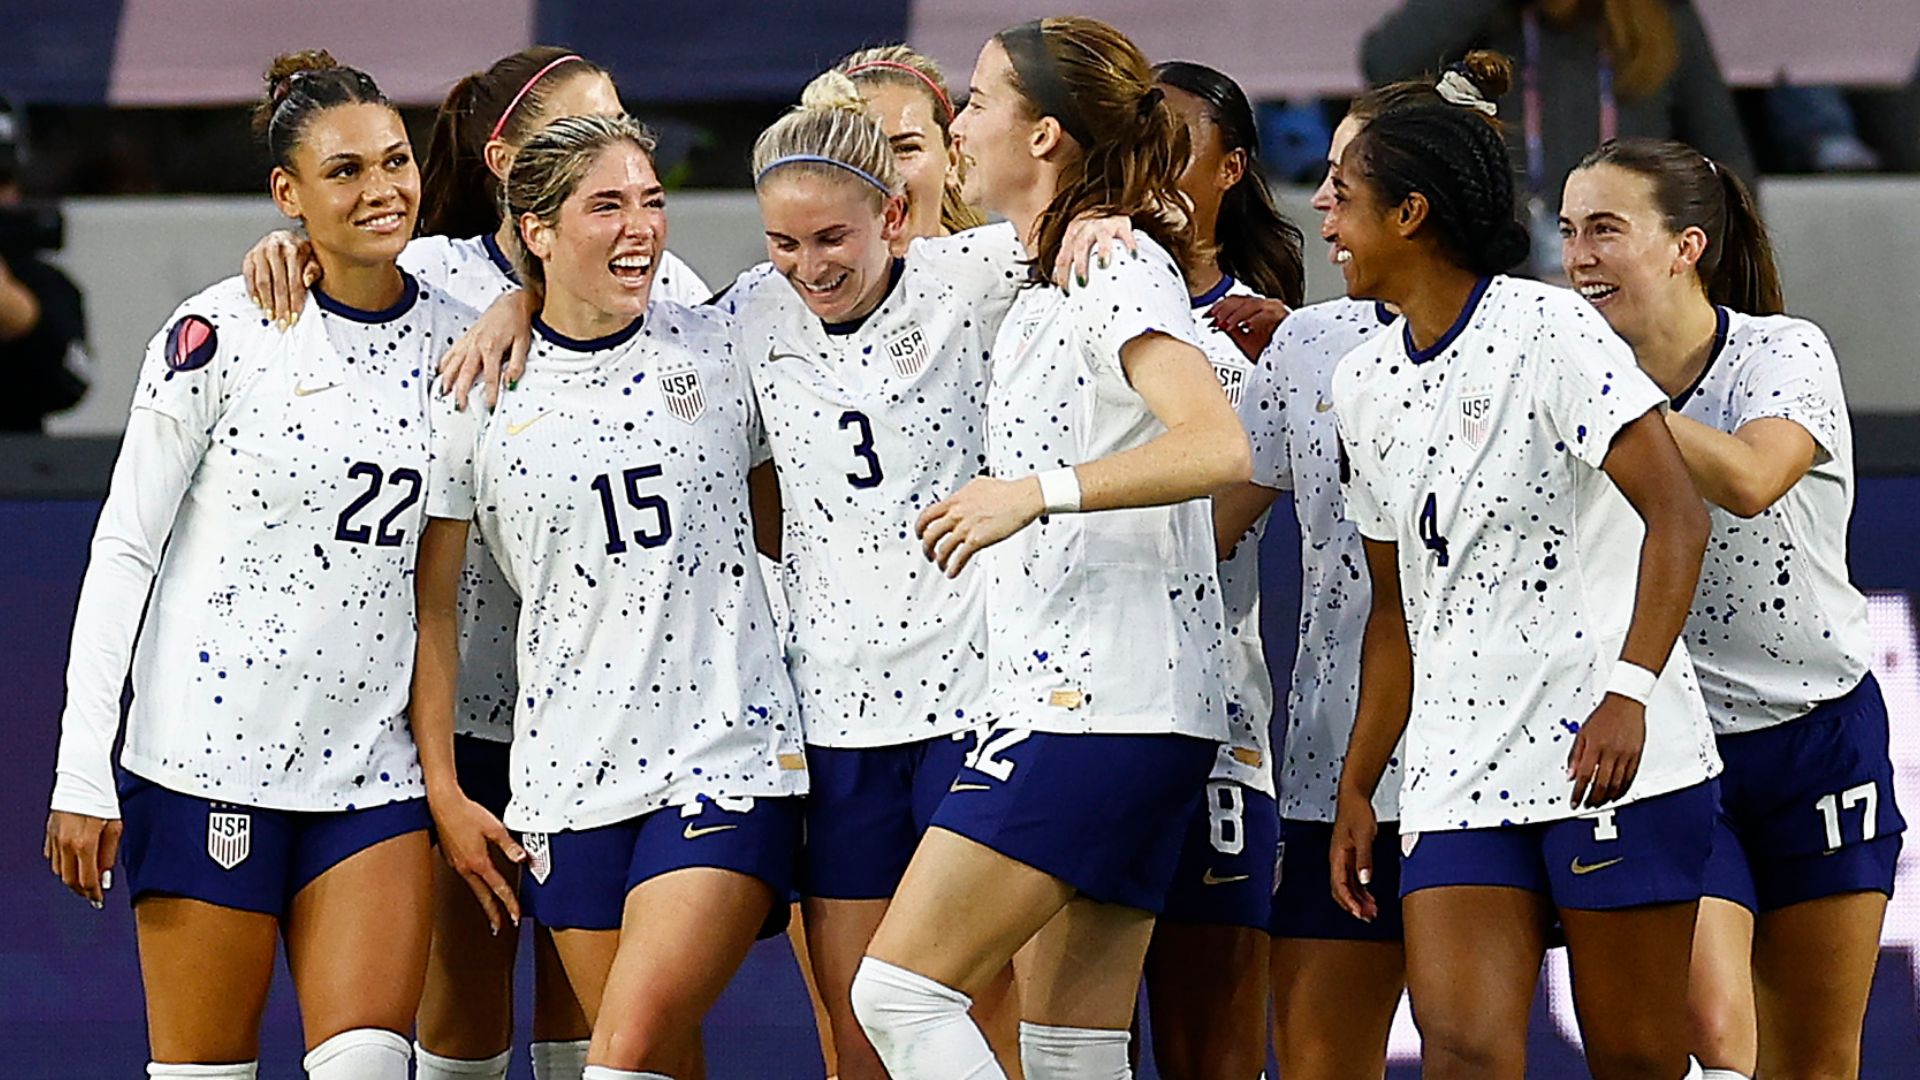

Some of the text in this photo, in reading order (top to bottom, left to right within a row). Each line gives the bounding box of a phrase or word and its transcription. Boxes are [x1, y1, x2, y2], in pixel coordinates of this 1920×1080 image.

[890, 331, 922, 357] USA
[662, 374, 697, 395] USA
[1463, 398, 1490, 419] USA
[838, 410, 884, 490] 3
[334, 461, 423, 547] 22
[591, 463, 673, 555] 15
[1419, 492, 1450, 567] 4
[212, 816, 248, 838] USA
[1206, 782, 1244, 855] 8
[1815, 781, 1878, 850] 17
